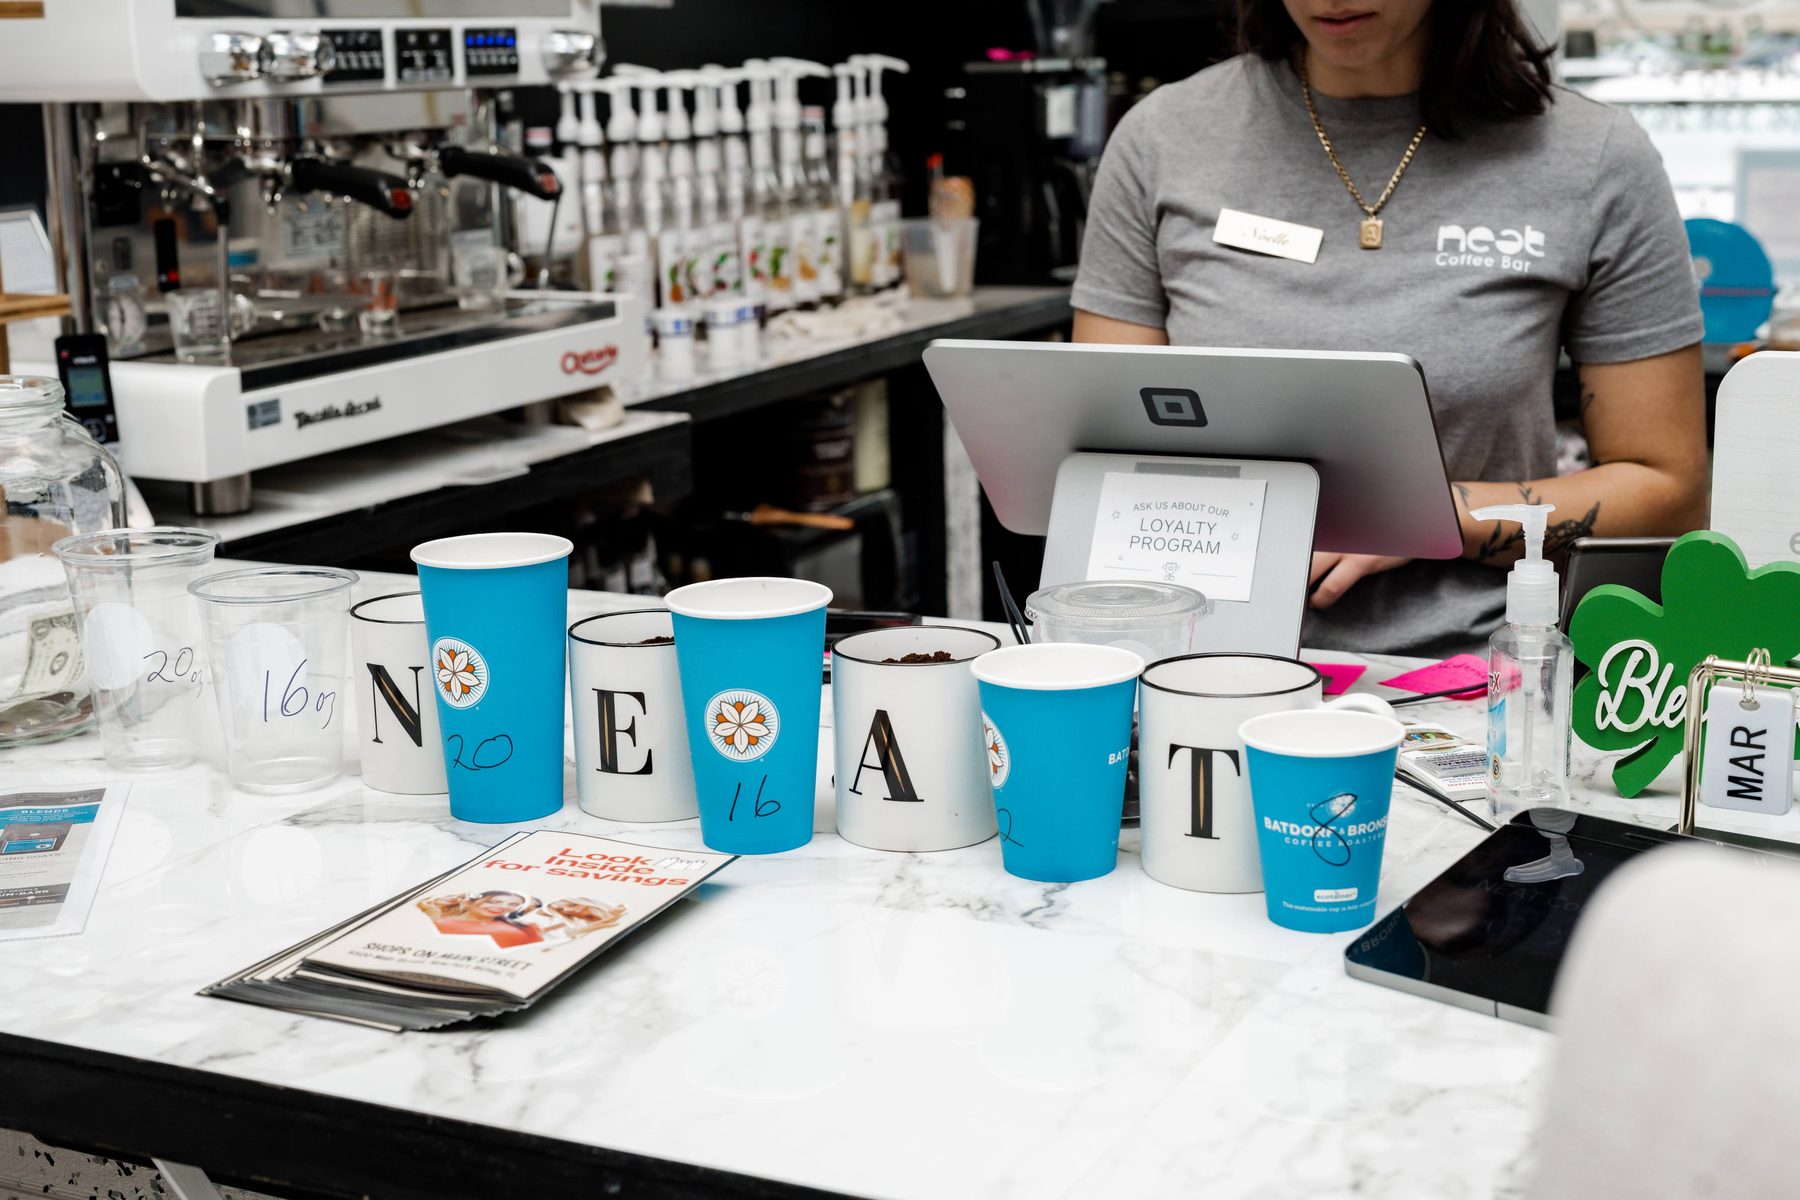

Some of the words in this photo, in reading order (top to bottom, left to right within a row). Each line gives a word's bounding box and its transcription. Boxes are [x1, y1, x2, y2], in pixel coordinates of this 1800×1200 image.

[1436, 224, 1546, 258] neat
[1435, 252, 1495, 268] Coffee
[1501, 254, 1532, 273] Bar
[1132, 501, 1153, 512] ASK
[1155, 501, 1169, 511] US
[1171, 501, 1206, 513] ABOUT
[1207, 505, 1230, 518] OUR
[1139, 517, 1218, 537] LOYALTY
[1129, 535, 1221, 555] PROGRAM
[1594, 639, 1708, 734] Ble
[366, 662, 424, 748] N
[592, 688, 653, 776] E
[447, 733, 514, 772] 20
[848, 708, 925, 803] A
[1726, 725, 1768, 802] MAR
[728, 773, 782, 822] 16
[1167, 743, 1241, 840] T
[1263, 815, 1337, 839] BATDORF
[1338, 827, 1346, 836] &
[1284, 836, 1332, 848] COFFEE
[1309, 792, 1359, 867] 8
[484, 858, 541, 873] for
[546, 868, 689, 887] savings
[543, 854, 656, 876] Inside
[557, 847, 657, 866] Look
[362, 941, 412, 955] SHOPS
[413, 948, 436, 959] ON
[439, 951, 478, 963] MAIN
[478, 954, 535, 972] STREET
